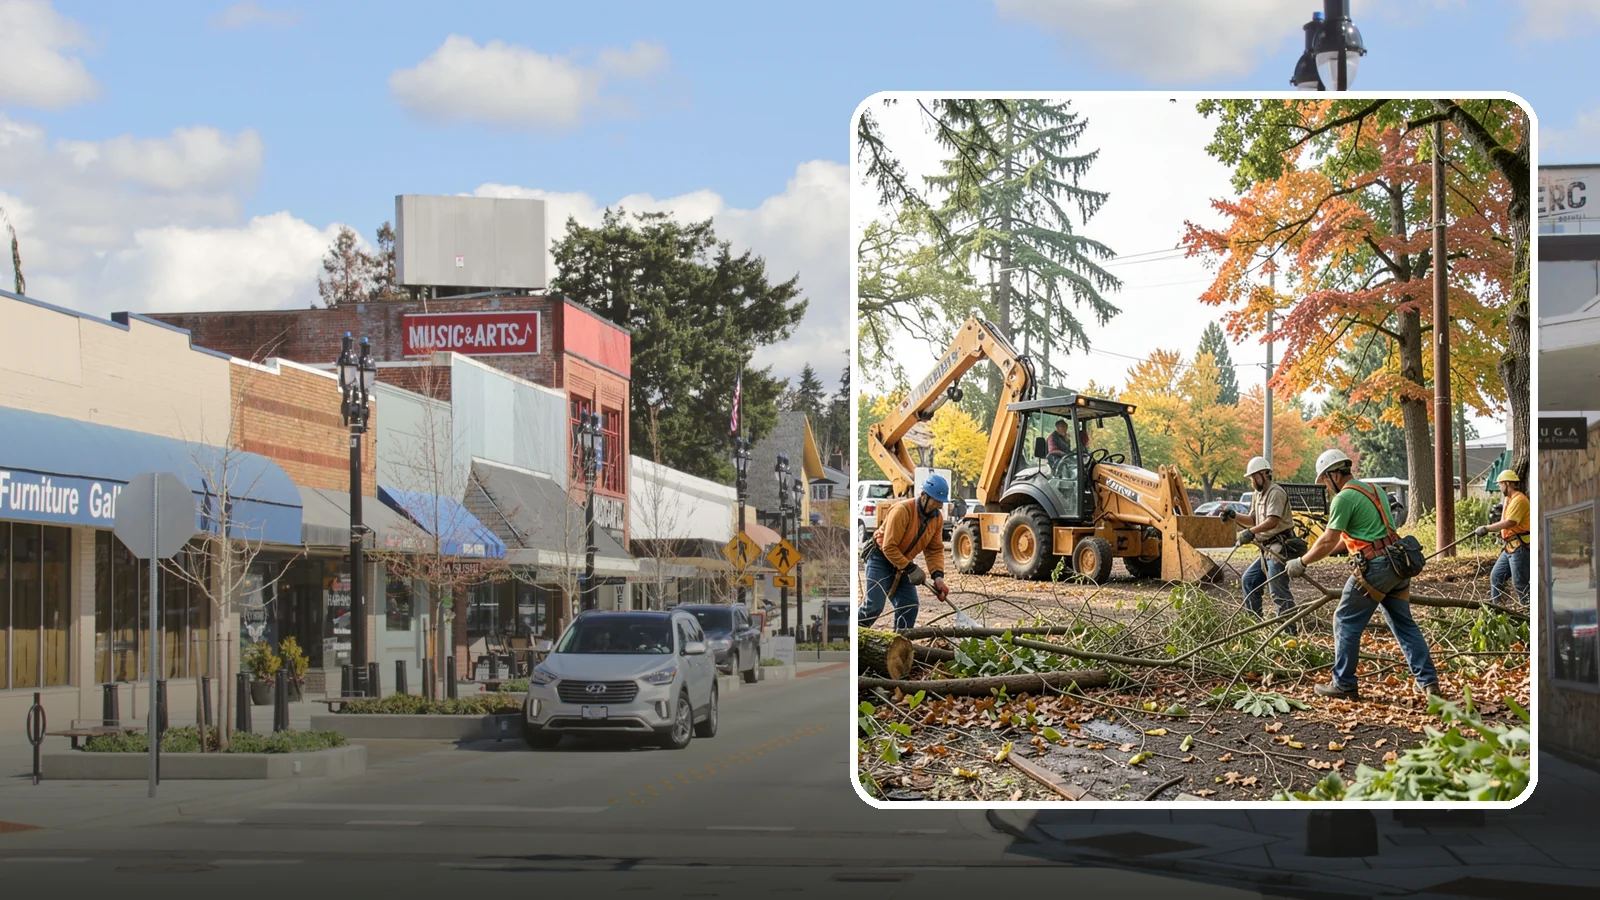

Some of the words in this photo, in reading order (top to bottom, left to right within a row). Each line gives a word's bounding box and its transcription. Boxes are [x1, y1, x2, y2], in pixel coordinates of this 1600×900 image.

[409, 323, 519, 349] MUSIC&ARTS
[0, 472, 79, 515] Furniture
[89, 483, 121, 519] Gal
